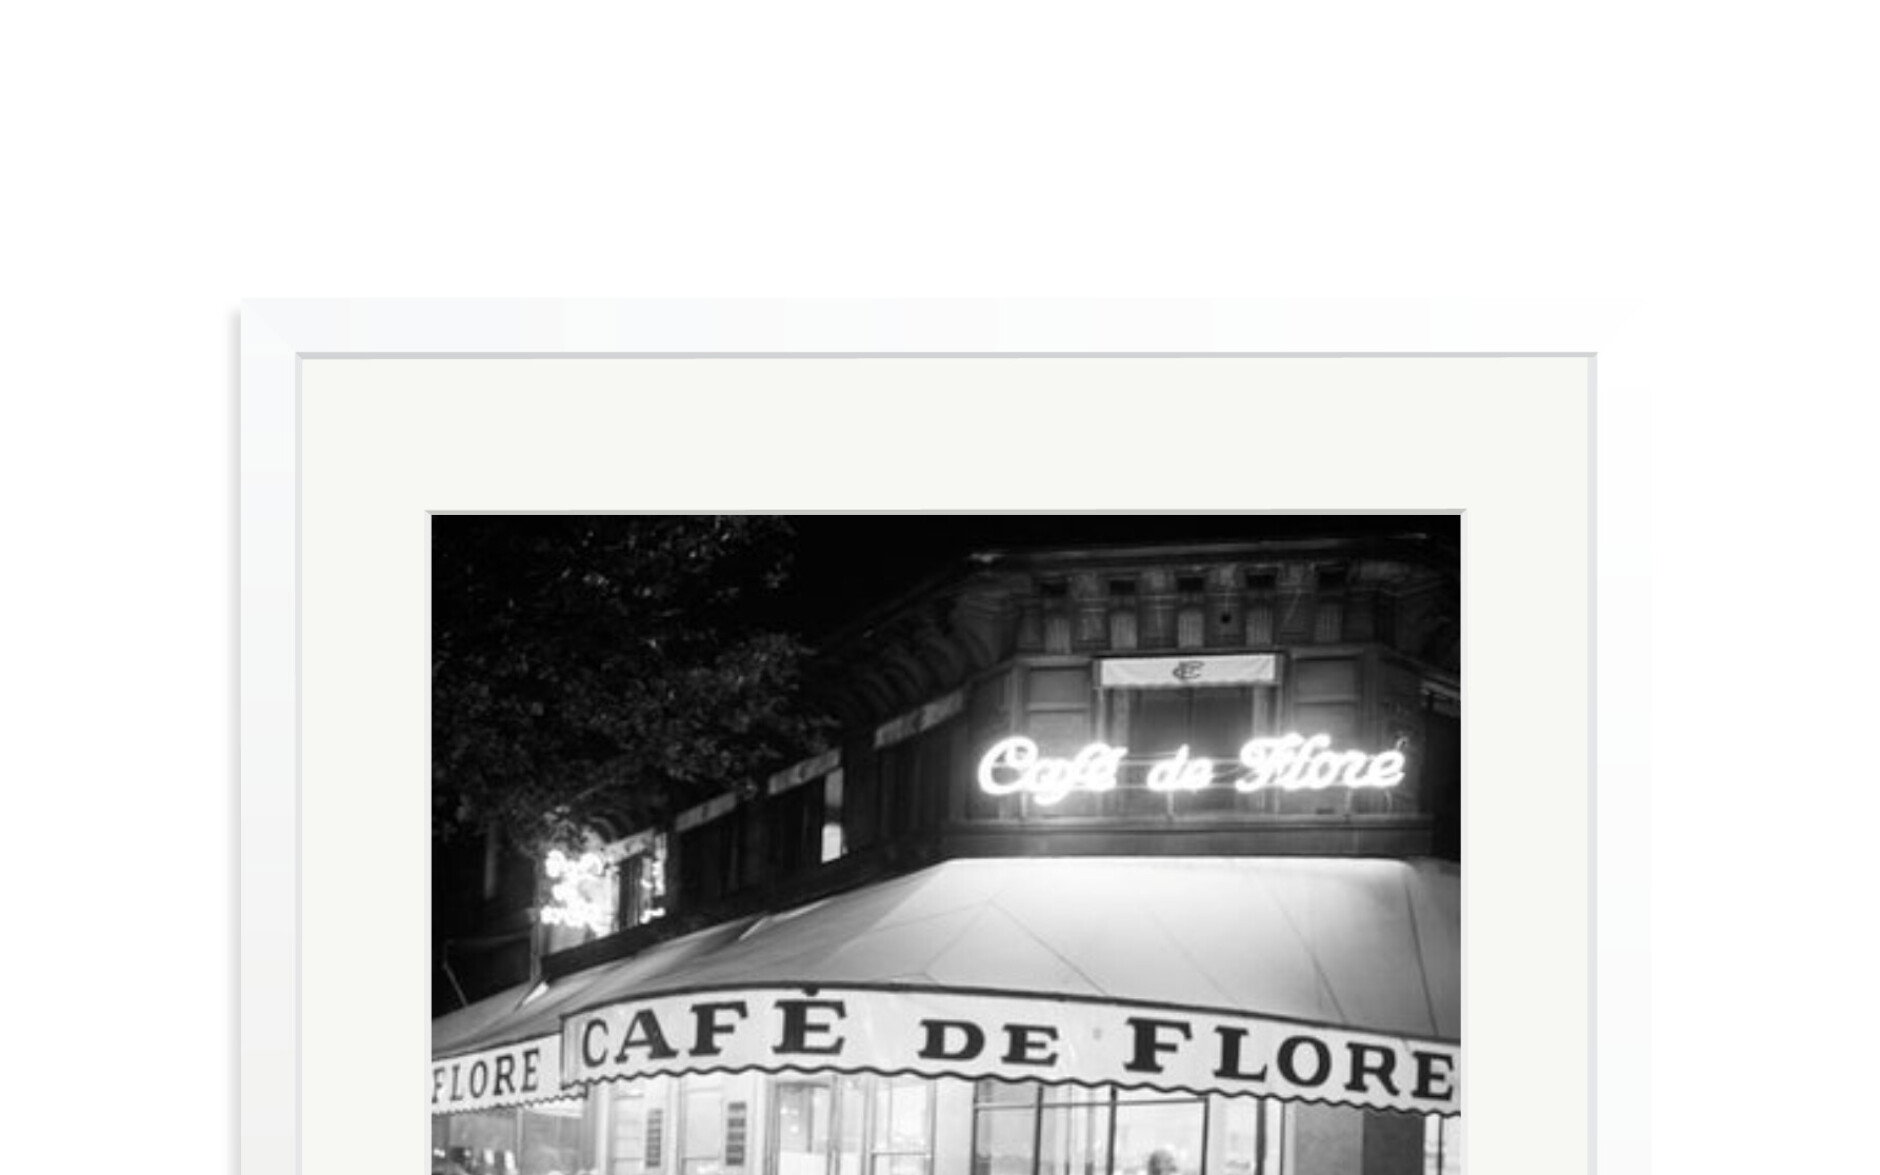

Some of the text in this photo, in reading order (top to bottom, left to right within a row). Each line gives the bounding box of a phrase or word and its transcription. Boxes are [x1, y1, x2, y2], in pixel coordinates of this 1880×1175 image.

[1146, 744, 1214, 792] de
[1234, 731, 1405, 793] Flore
[431, 1048, 540, 1104] FLORE
[917, 1018, 1061, 1067] DE
[1123, 1016, 1455, 1101] FLORE
